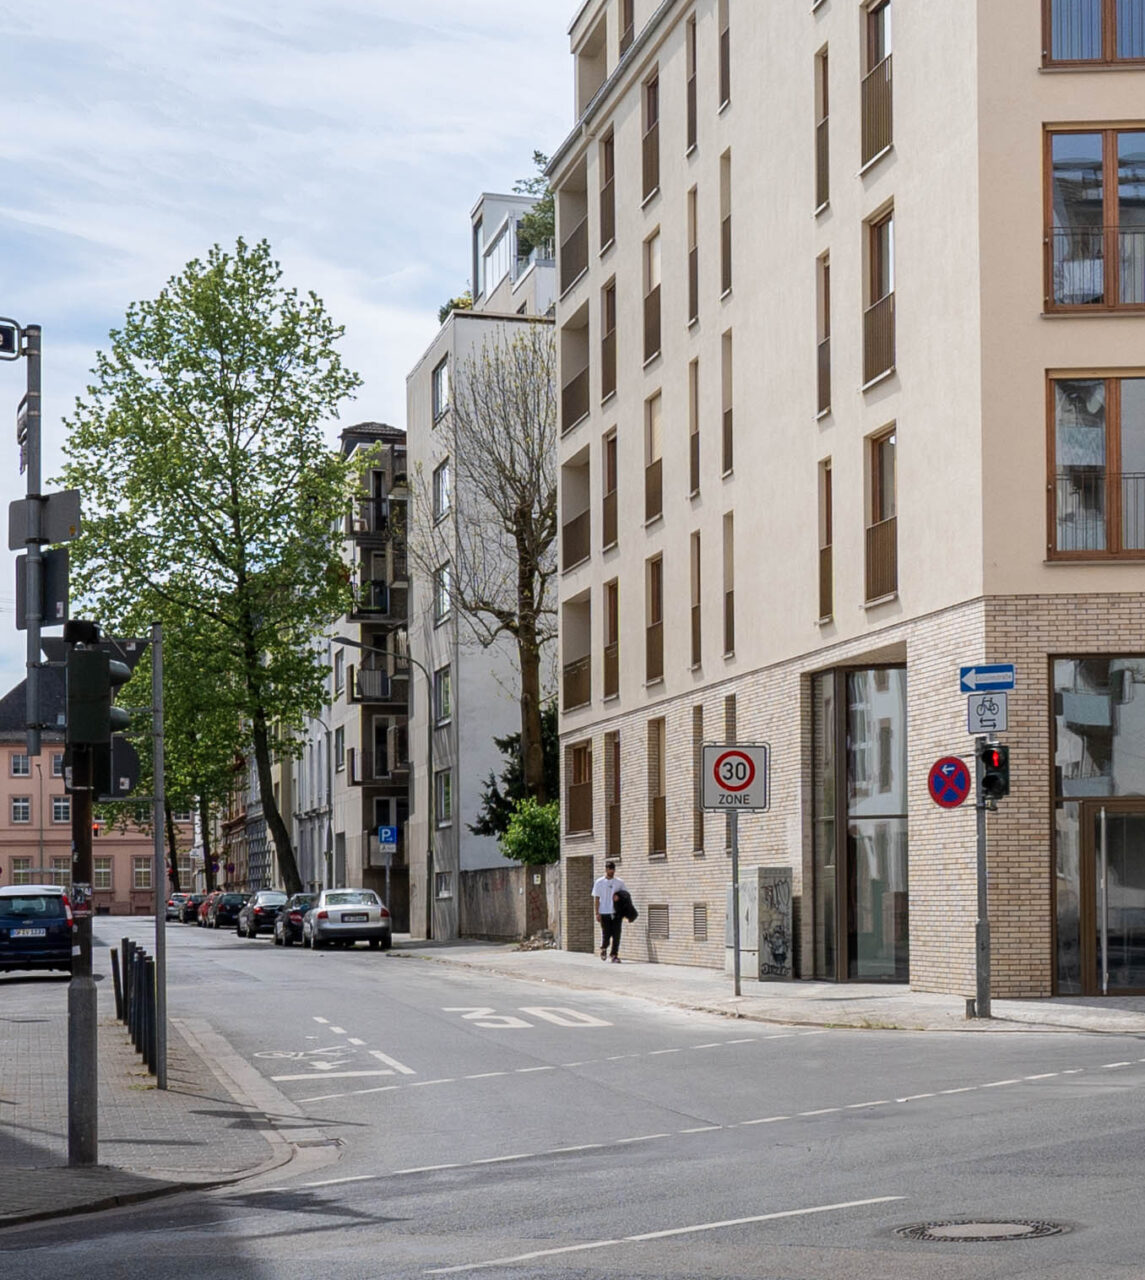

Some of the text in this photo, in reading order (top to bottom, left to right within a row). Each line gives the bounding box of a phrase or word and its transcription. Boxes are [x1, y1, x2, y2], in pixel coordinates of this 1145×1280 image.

[722, 762, 746, 780] 30
[718, 793, 751, 805] ZONE
[381, 828, 391, 841] P
[441, 1006, 615, 1028] 30
